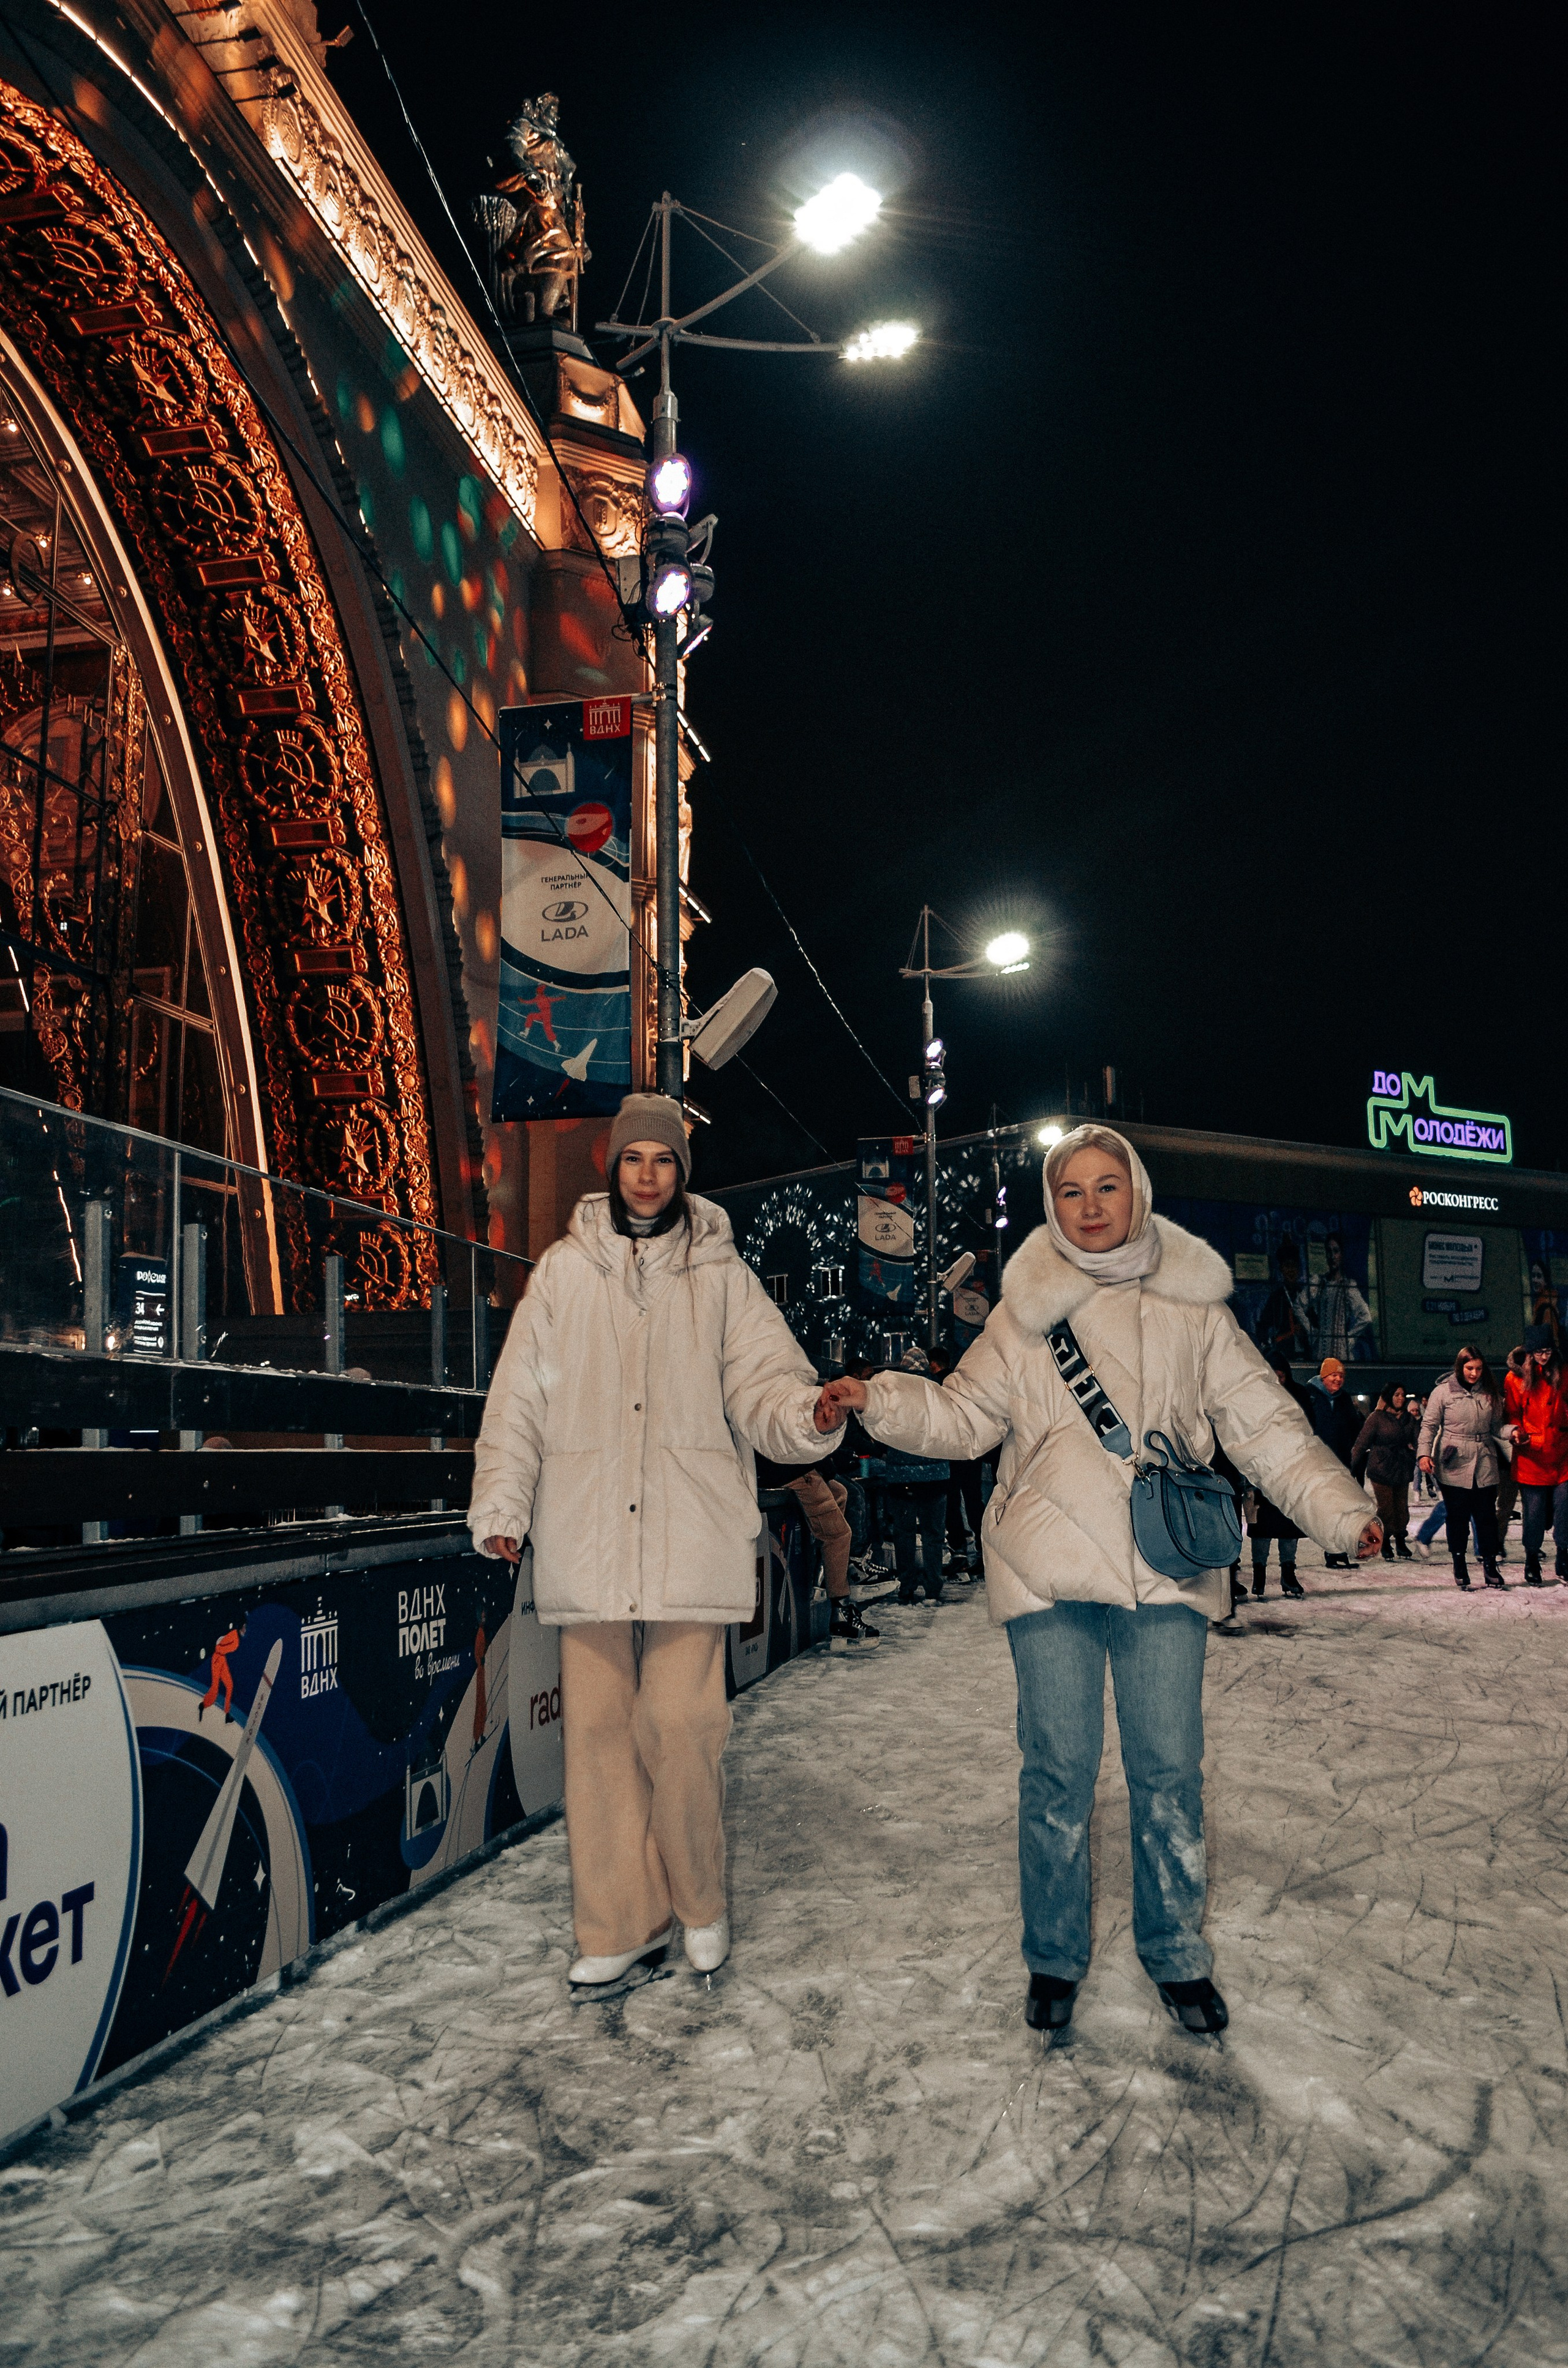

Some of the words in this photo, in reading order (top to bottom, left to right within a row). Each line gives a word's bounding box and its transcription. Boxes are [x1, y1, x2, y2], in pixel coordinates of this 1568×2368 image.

[590, 724, 620, 735] ВДНХ
[541, 925, 589, 942] LADA
[1372, 1071, 1434, 1106] ДОМ
[1379, 1110, 1505, 1151] МОЛОДЁЖИ
[1422, 1190, 1499, 1211] РОСКОНГРЕСС
[135, 1302, 145, 1315] 34
[398, 1583, 446, 1624] ВДНХ
[399, 1618, 447, 1658] ПОЛЕТ
[301, 1666, 338, 1699] ВДНХ
[415, 1655, 424, 1680] во
[427, 1652, 460, 1686] времени
[13, 1673, 91, 1717] ПАРТНЁР
